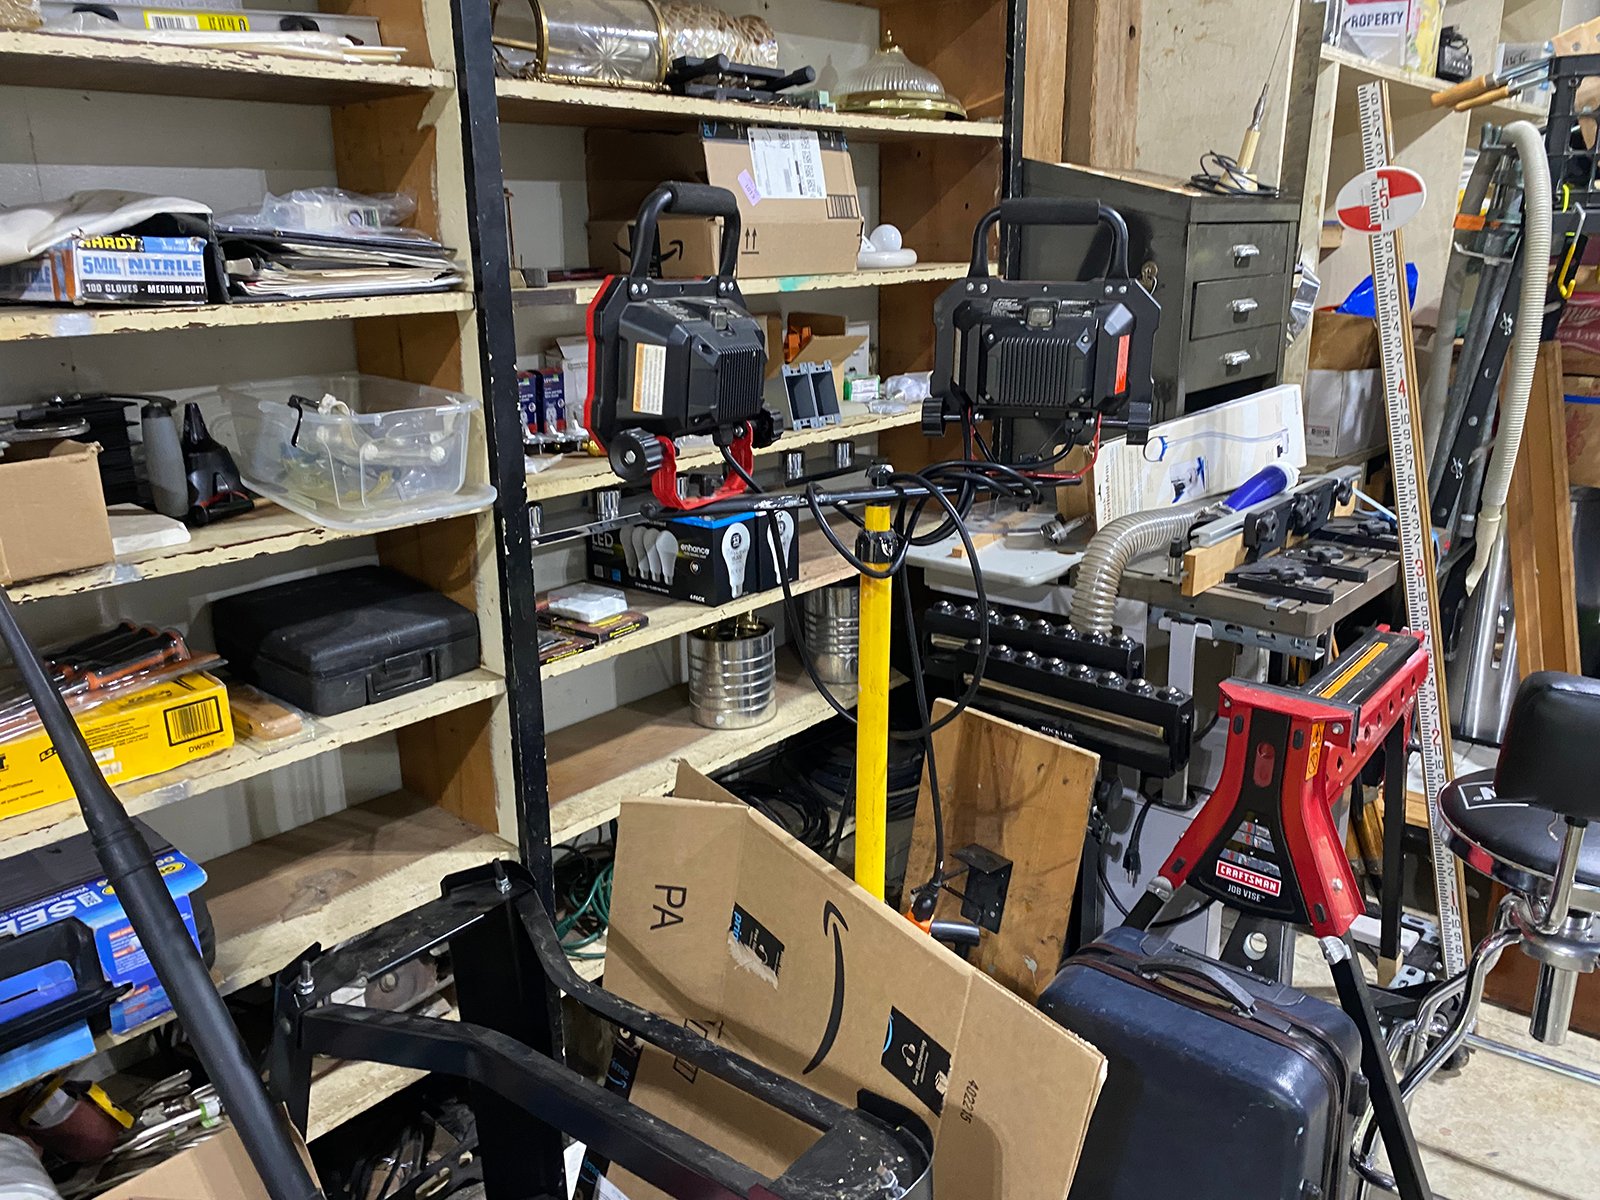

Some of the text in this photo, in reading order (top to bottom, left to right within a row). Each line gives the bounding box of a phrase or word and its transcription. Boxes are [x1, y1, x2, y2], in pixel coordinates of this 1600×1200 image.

[1372, 110, 1380, 121] 5
[1374, 127, 1381, 138] 4
[1376, 144, 1383, 155] 3
[1379, 188, 1389, 208] 5
[1382, 209, 1389, 220] 11
[80, 236, 138, 250] HARDY
[129, 258, 203, 271] NITRILE
[1386, 257, 1394, 269] 8
[1388, 273, 1395, 285] 7
[86, 283, 102, 293] 100
[105, 284, 139, 294] GLOVES
[148, 284, 183, 295] MEDIUM
[185, 285, 205, 295] DUTY
[1389, 289, 1397, 301] 6
[1391, 305, 1399, 317] 5
[1393, 321, 1400, 332] 4
[1394, 337, 1402, 348] 3
[1396, 352, 1403, 363] 2
[1398, 379, 1406, 397] 4
[1400, 398, 1407, 410] 11
[1400, 414, 1410, 425] 10
[1403, 429, 1411, 440] 9
[1404, 444, 1412, 455] 8
[1406, 459, 1413, 470] 7
[1407, 474, 1415, 485] 6
[1409, 489, 1417, 500] 5
[1411, 504, 1418, 515] 4
[1412, 519, 1420, 530] 3
[591, 531, 614, 548] LED
[1413, 534, 1421, 544] 2
[1415, 559, 1424, 577] 3
[1417, 577, 1425, 588] 11
[1418, 591, 1427, 602] 10
[1420, 606, 1428, 617] 9
[1422, 620, 1430, 631] 8
[1423, 635, 1431, 645] 7
[1428, 677, 1435, 687] 4
[1429, 691, 1436, 701] 3
[1430, 705, 1437, 715] 2
[1432, 728, 1441, 746] 2
[1434, 746, 1442, 756] 11
[1435, 760, 1444, 770] 10
[1437, 773, 1445, 783] 9
[1445, 854, 1453, 864] 3
[1447, 868, 1454, 877] 2
[1220, 865, 1277, 892] CRAFTSMAN
[1228, 884, 1242, 896] JOB
[650, 884, 687, 931] PA
[1451, 906, 1459, 916] 11
[1451, 919, 1460, 929] 10
[1454, 932, 1461, 942] 9
[1455, 945, 1462, 954] 8
[960, 1079, 979, 1124] 402215
